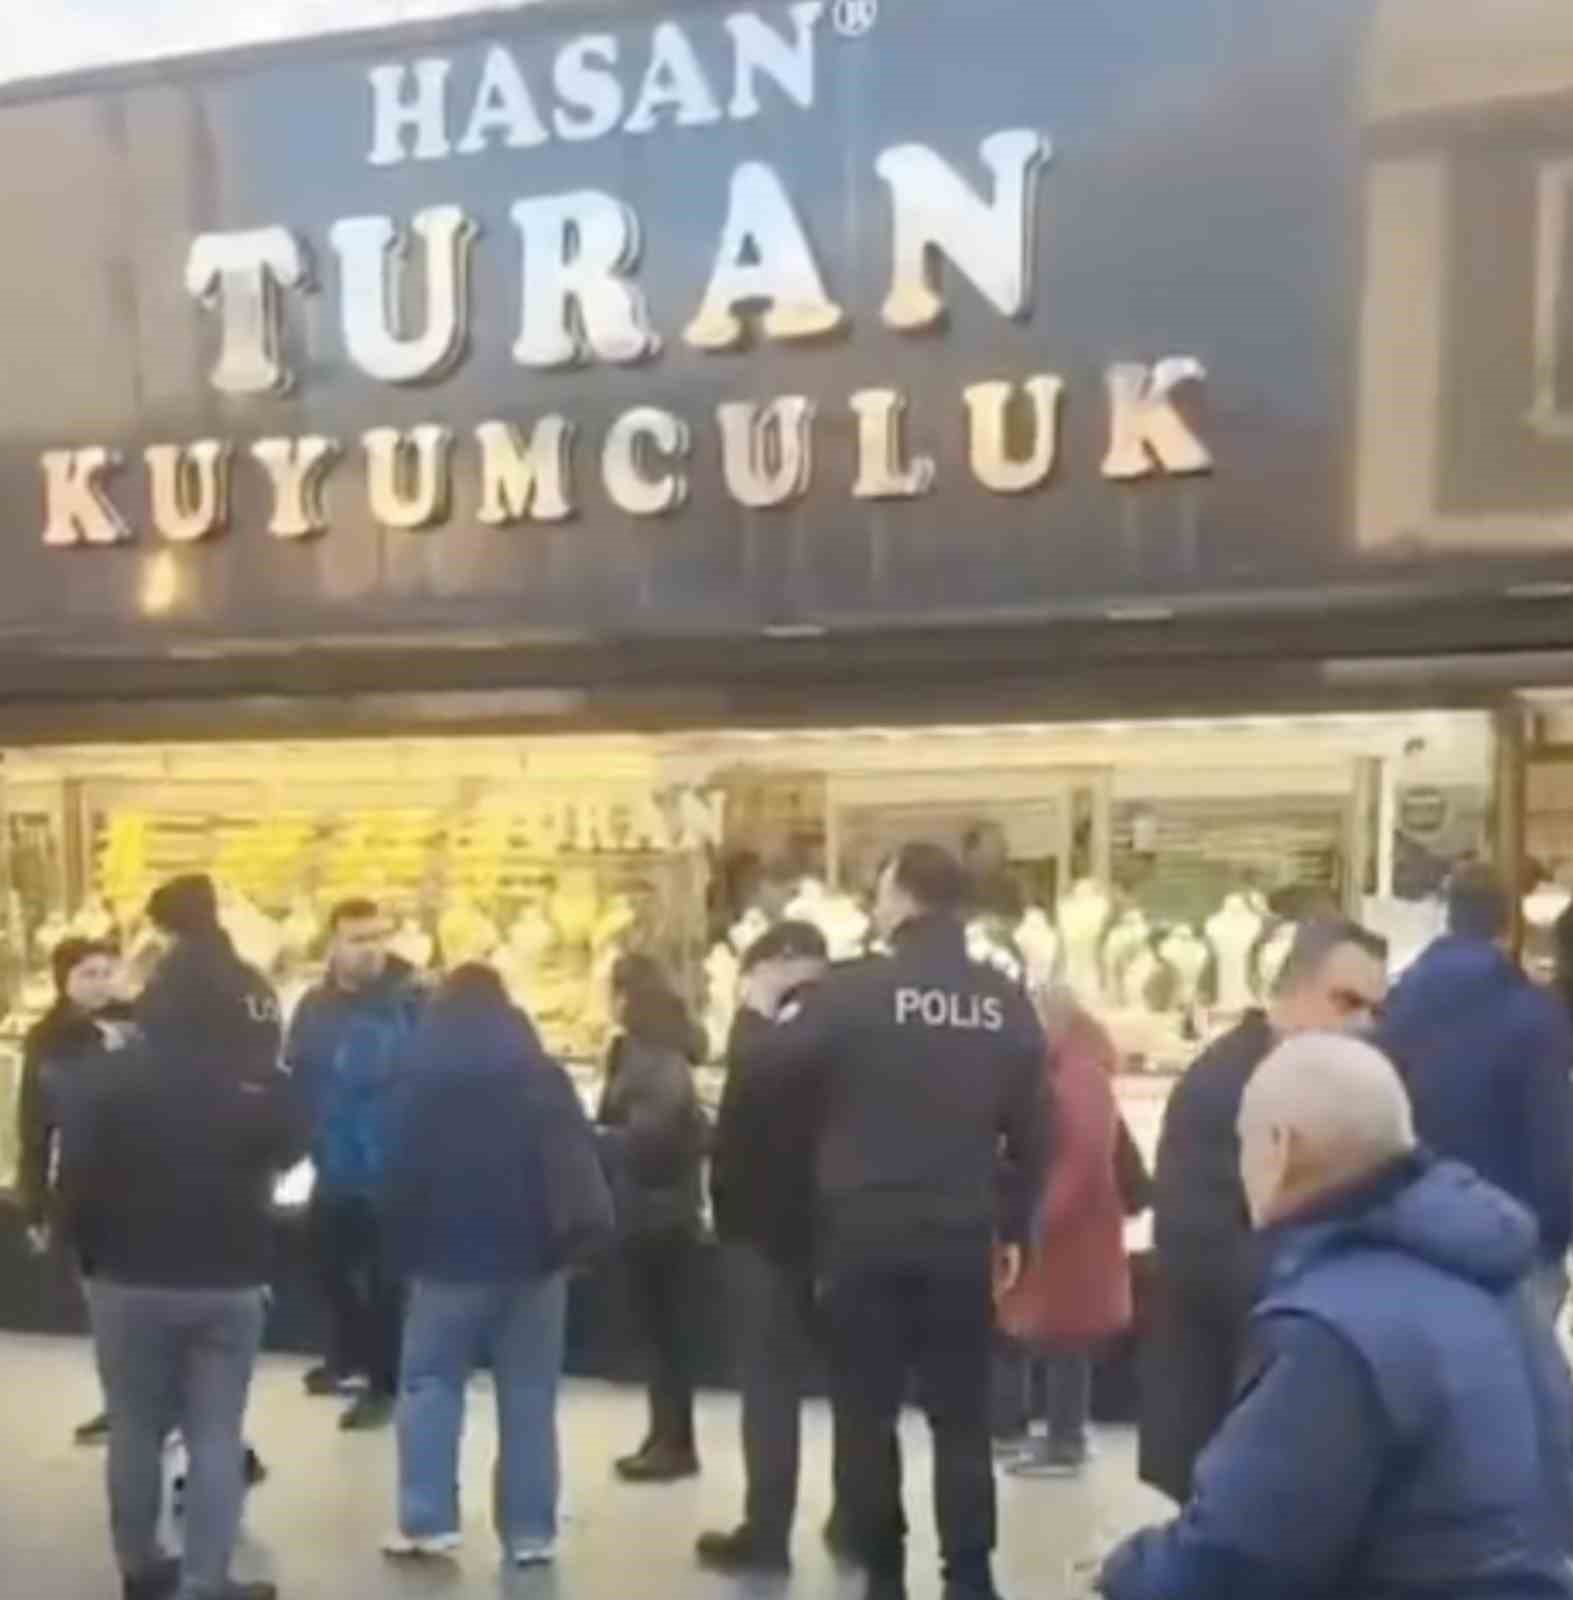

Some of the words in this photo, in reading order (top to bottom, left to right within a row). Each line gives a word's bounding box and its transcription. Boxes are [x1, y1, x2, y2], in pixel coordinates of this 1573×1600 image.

[366, 1, 820, 166] HASAN
[186, 128, 1050, 395] TURAN
[41, 356, 1213, 547] KUYUMCULUK
